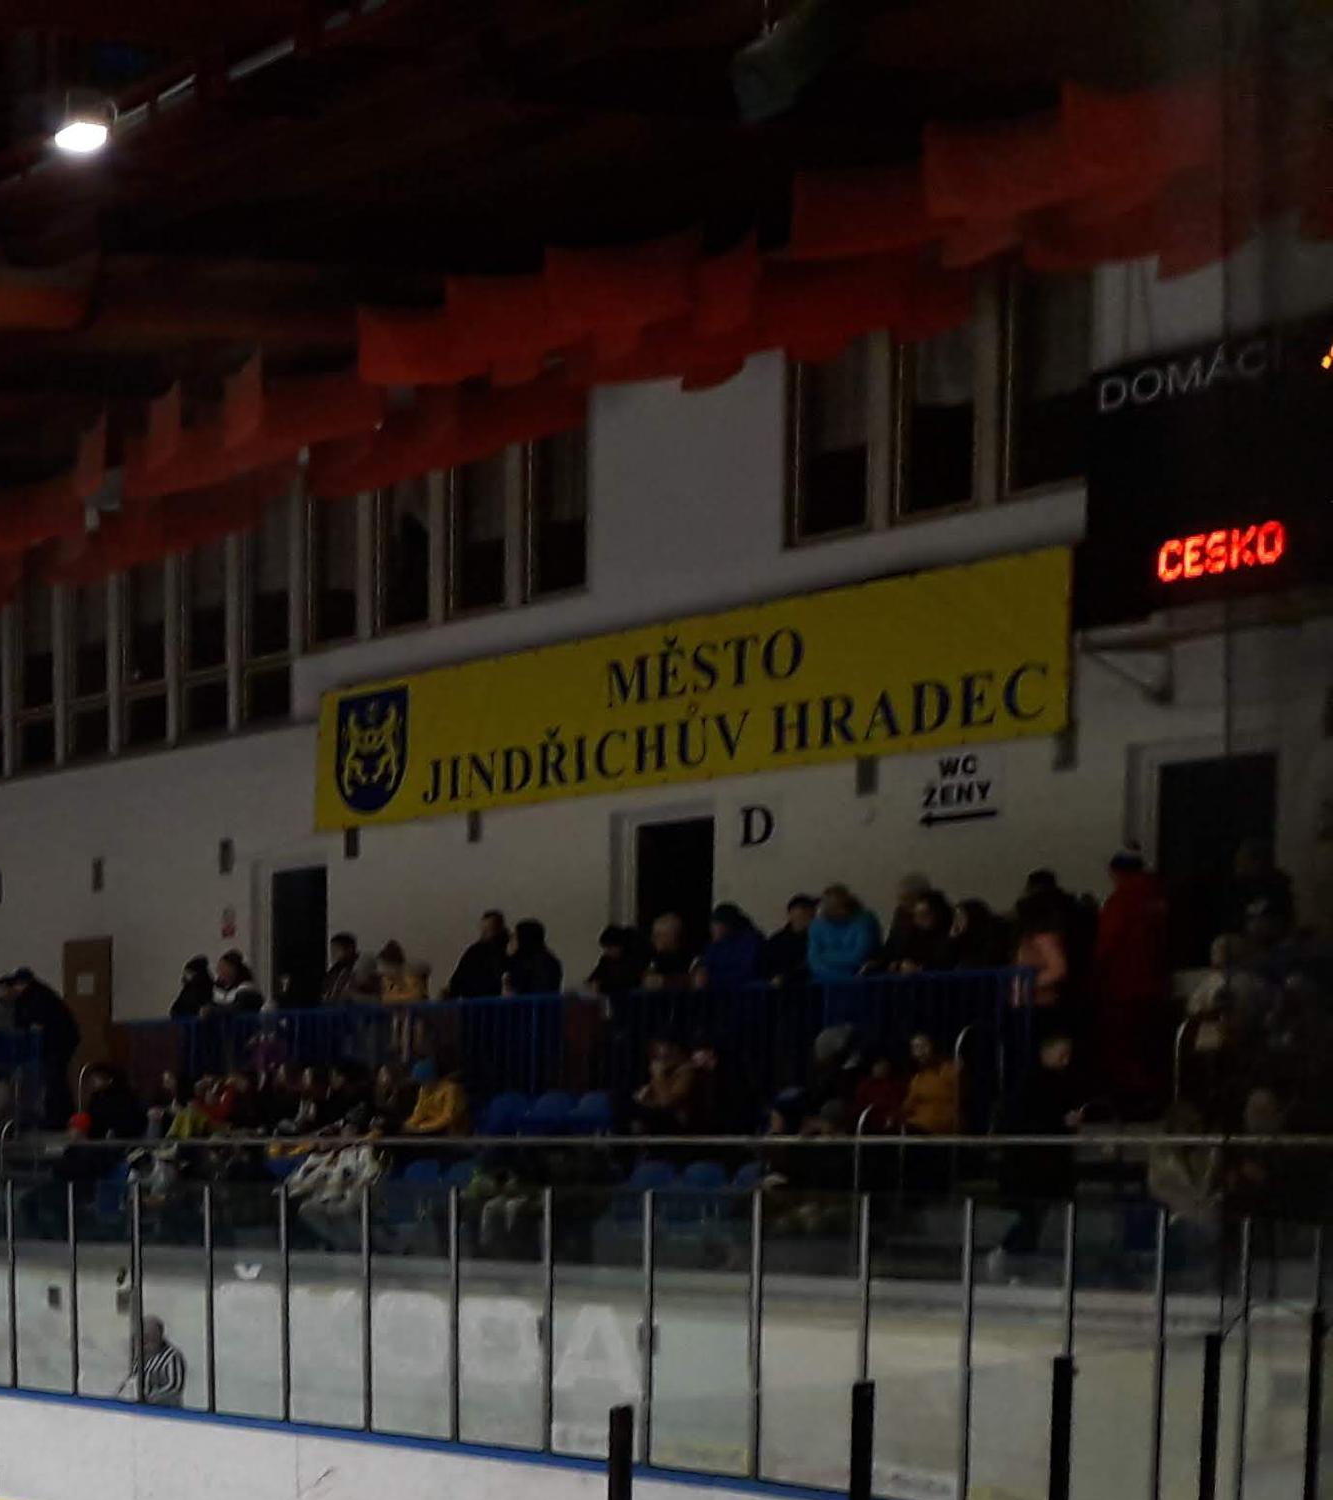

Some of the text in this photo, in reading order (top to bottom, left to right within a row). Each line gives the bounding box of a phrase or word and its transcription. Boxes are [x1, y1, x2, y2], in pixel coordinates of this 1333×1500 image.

[1156, 519, 1285, 585] CESKO
[607, 626, 804, 708] MĚSTO
[421, 663, 1049, 803] JINDŘICHŮV HRADEC
[939, 754, 978, 777] WC
[922, 780, 992, 807] ŽENY
[740, 807, 774, 846] D
